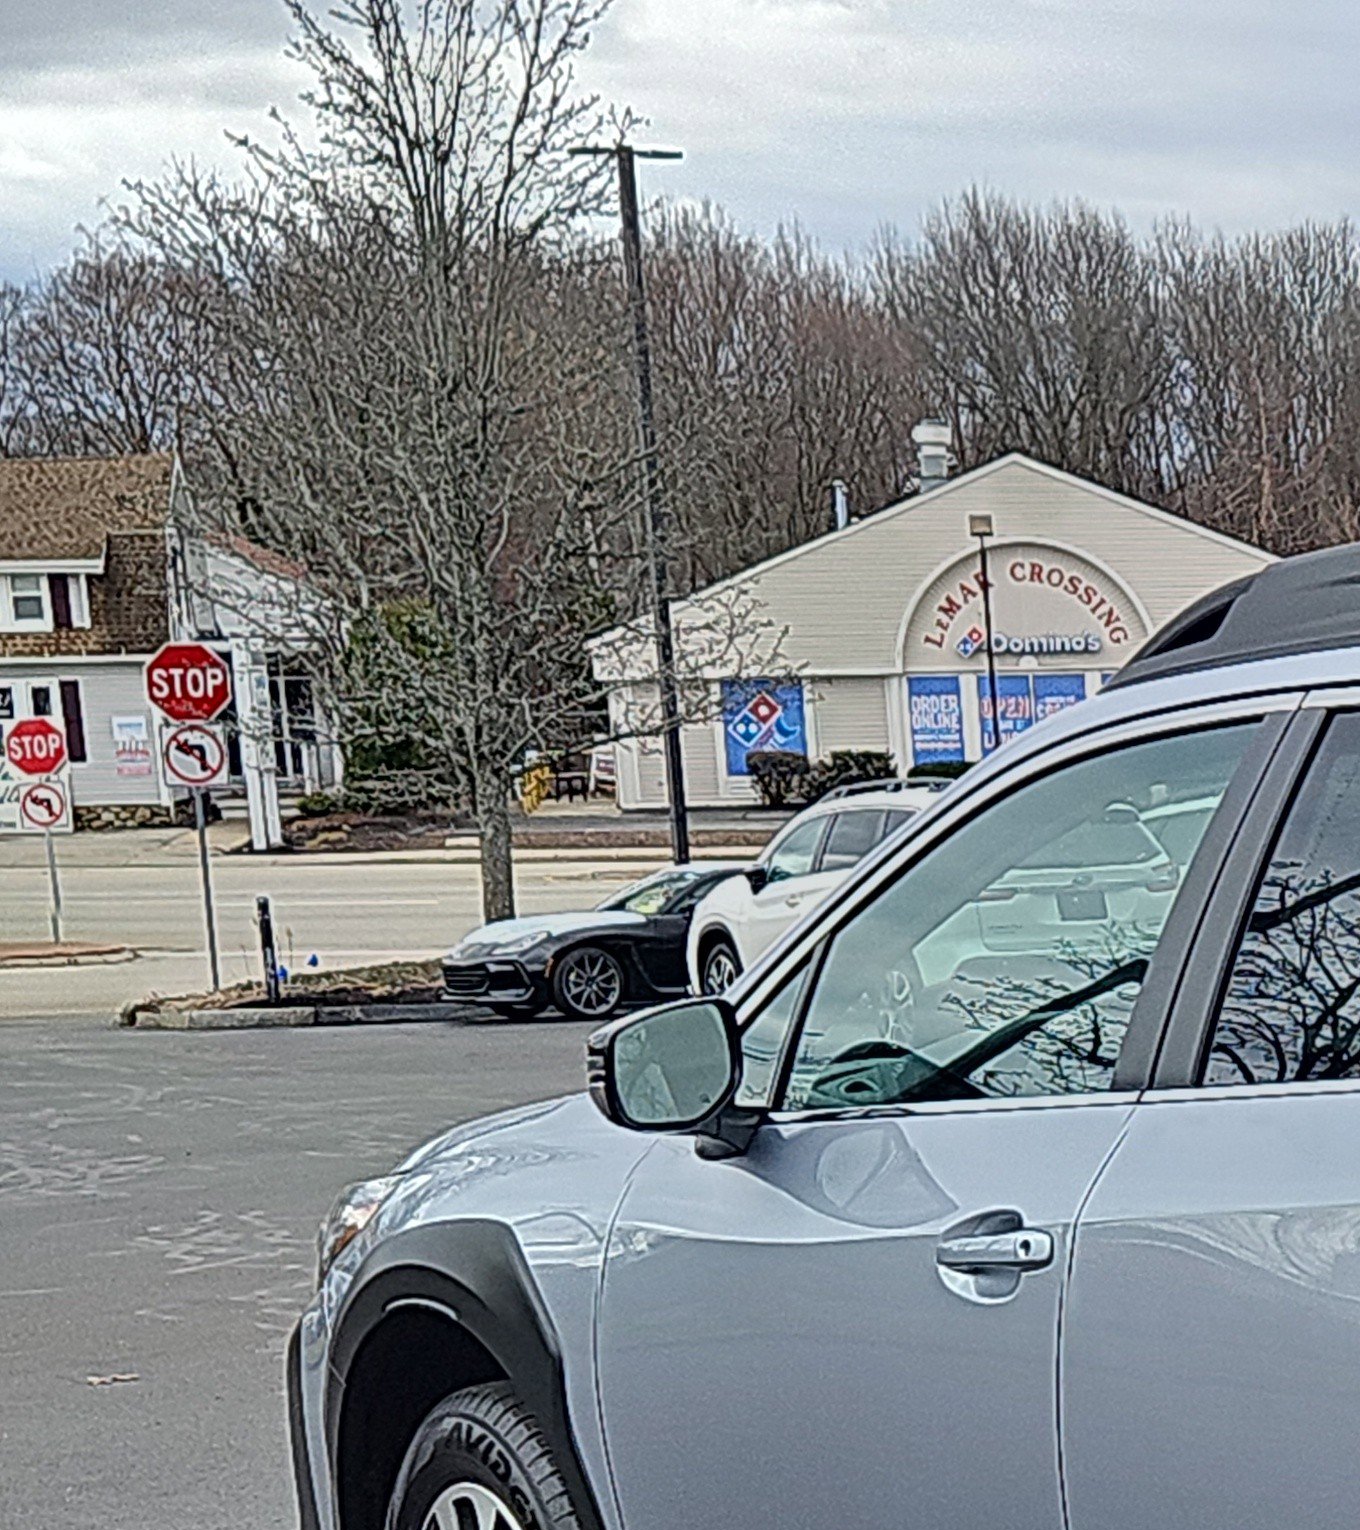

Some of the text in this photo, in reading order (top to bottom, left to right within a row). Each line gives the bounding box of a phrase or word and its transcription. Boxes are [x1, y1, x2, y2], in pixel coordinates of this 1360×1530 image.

[1009, 561, 1129, 646] CROSSING
[990, 631, 1101, 654] Domino's
[152, 668, 224, 699] STOP
[911, 694, 958, 713] ORDER
[912, 711, 961, 730] ONLINE
[9, 732, 61, 760] STOP
